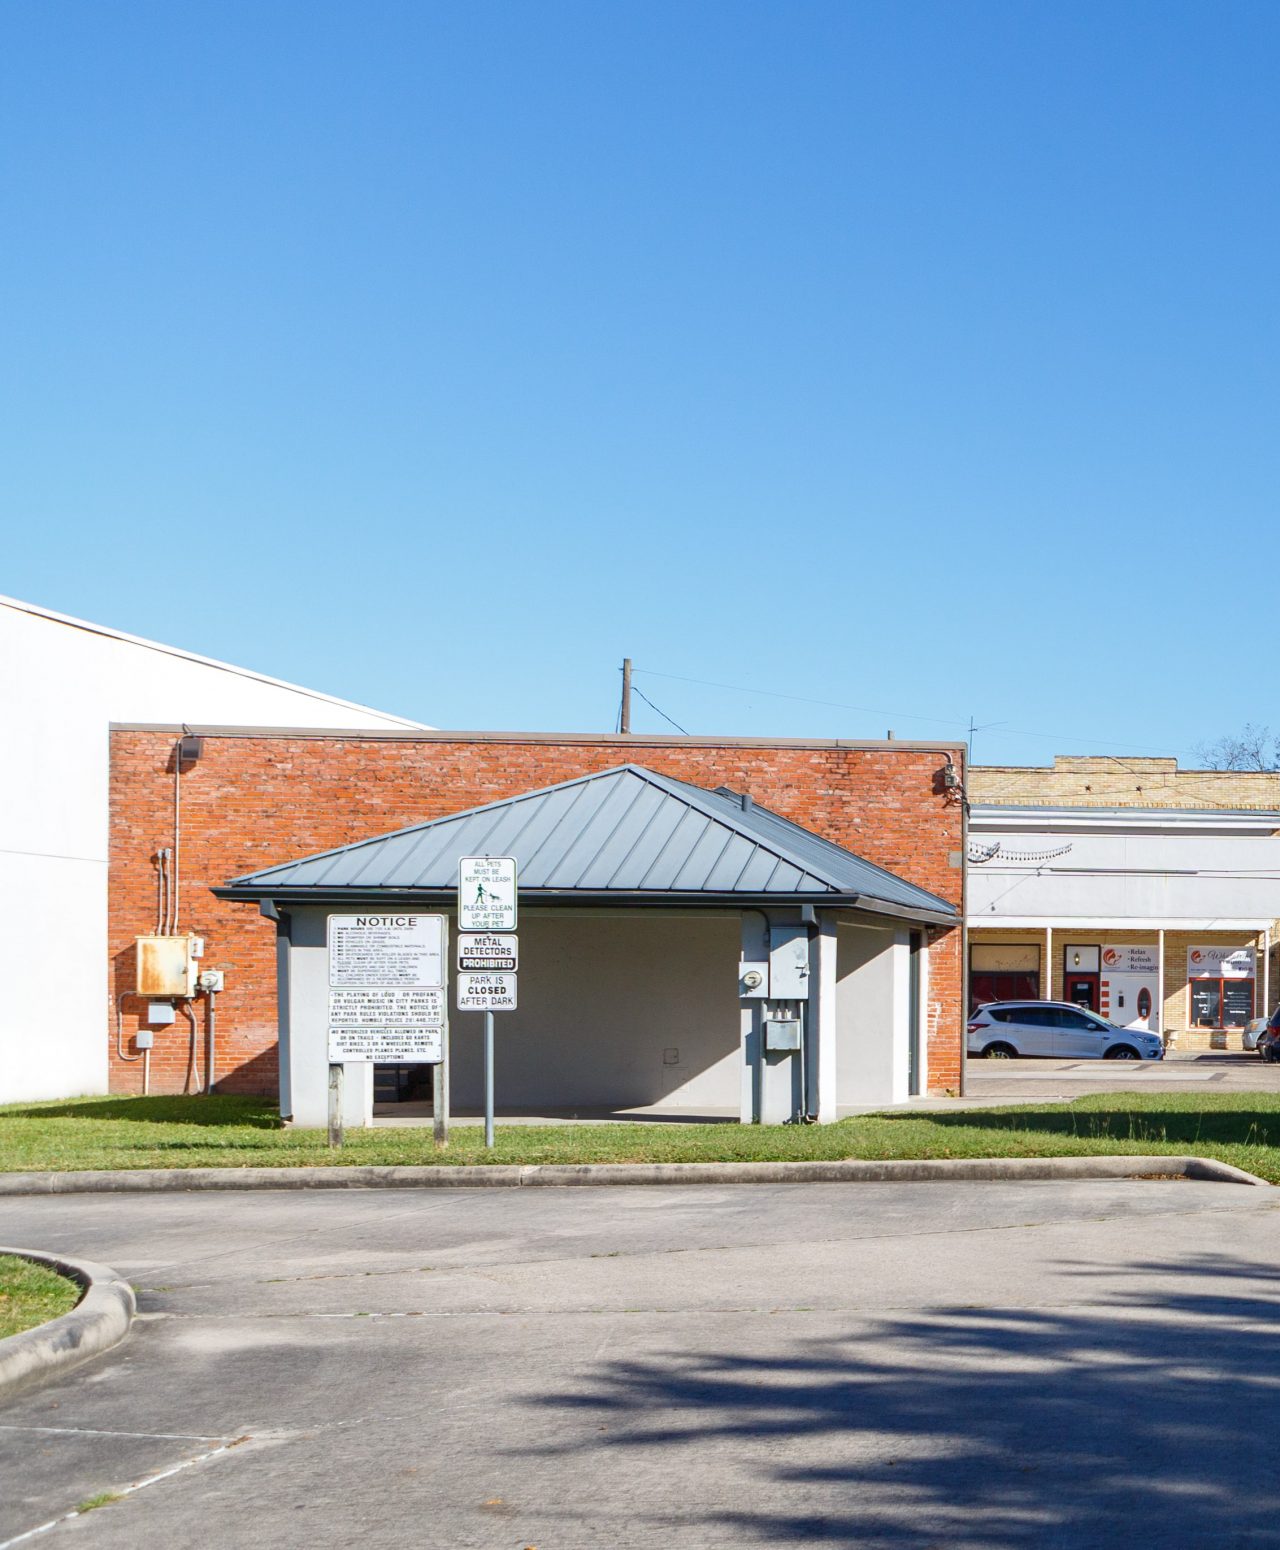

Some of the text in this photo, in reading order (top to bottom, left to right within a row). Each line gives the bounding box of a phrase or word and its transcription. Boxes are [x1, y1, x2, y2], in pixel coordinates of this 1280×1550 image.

[356, 917, 417, 926] NOTICE
[474, 938, 502, 946] METAL
[464, 947, 512, 955] DETECTORS
[463, 959, 514, 967] PROHIBITED
[461, 997, 513, 1005] AFTER DARK
